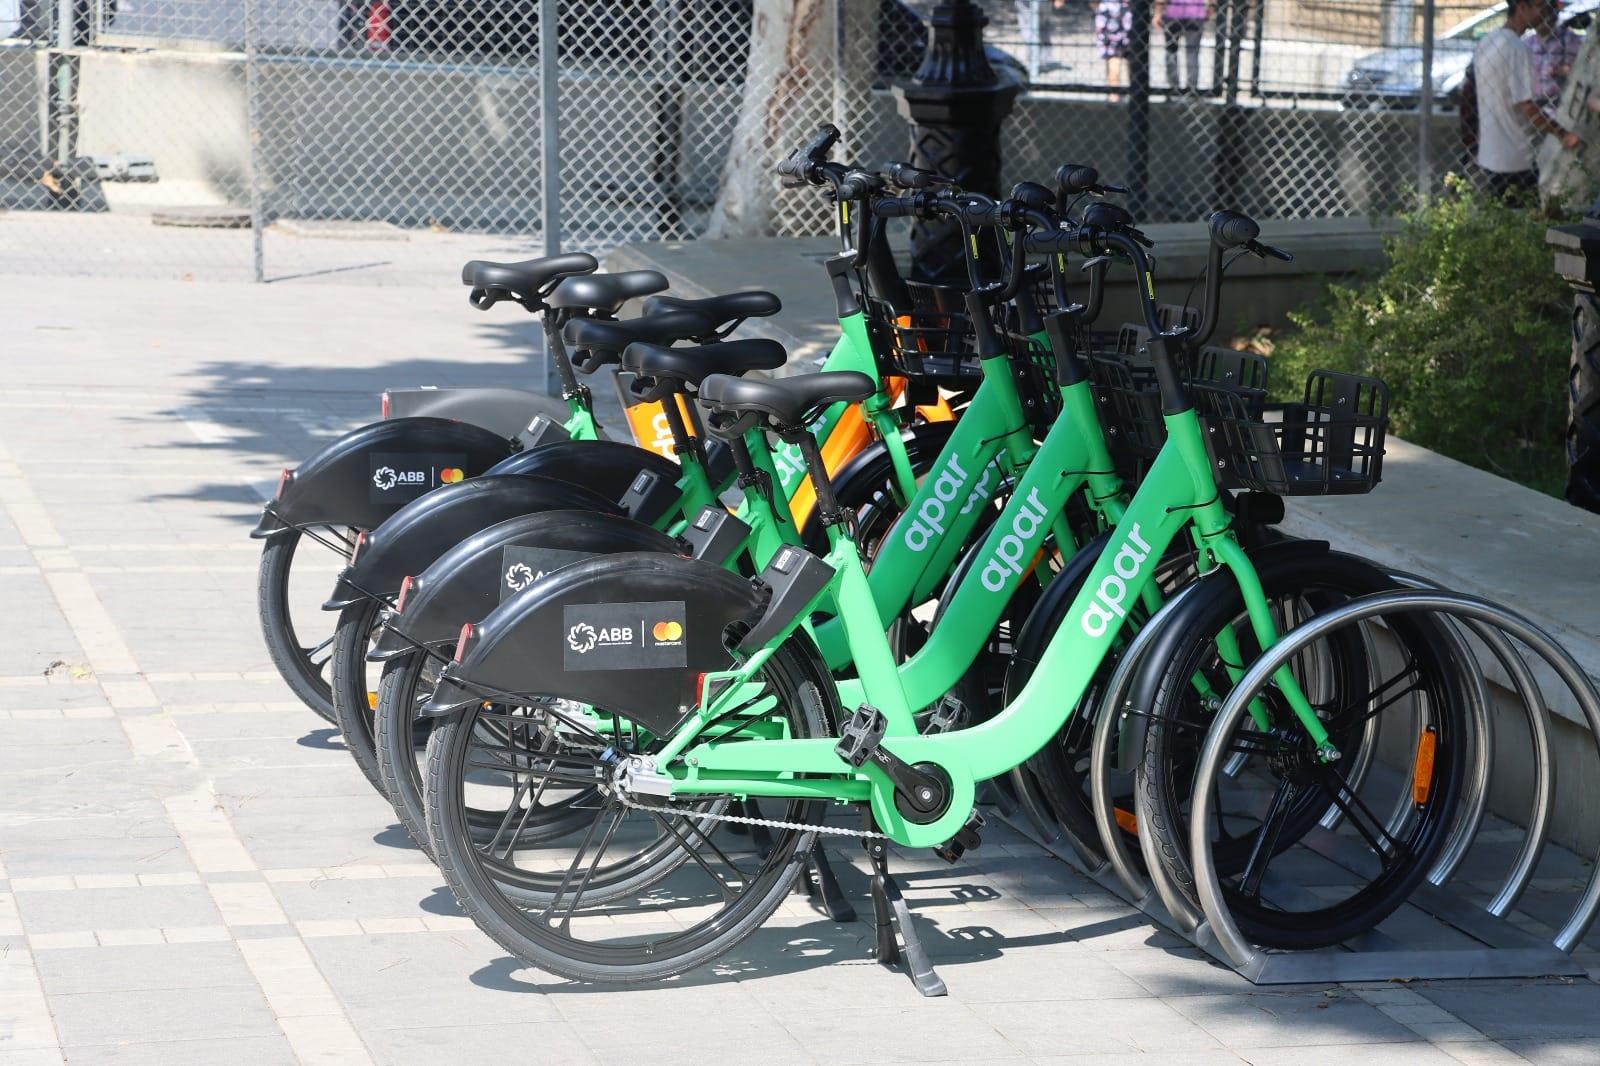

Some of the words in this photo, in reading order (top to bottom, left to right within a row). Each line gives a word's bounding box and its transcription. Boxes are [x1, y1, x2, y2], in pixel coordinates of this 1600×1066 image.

[397, 471, 426, 482] ABB
[904, 451, 968, 552] apar
[980, 486, 1049, 593] apar
[1080, 521, 1152, 638] apar
[598, 627, 633, 642] ABB
